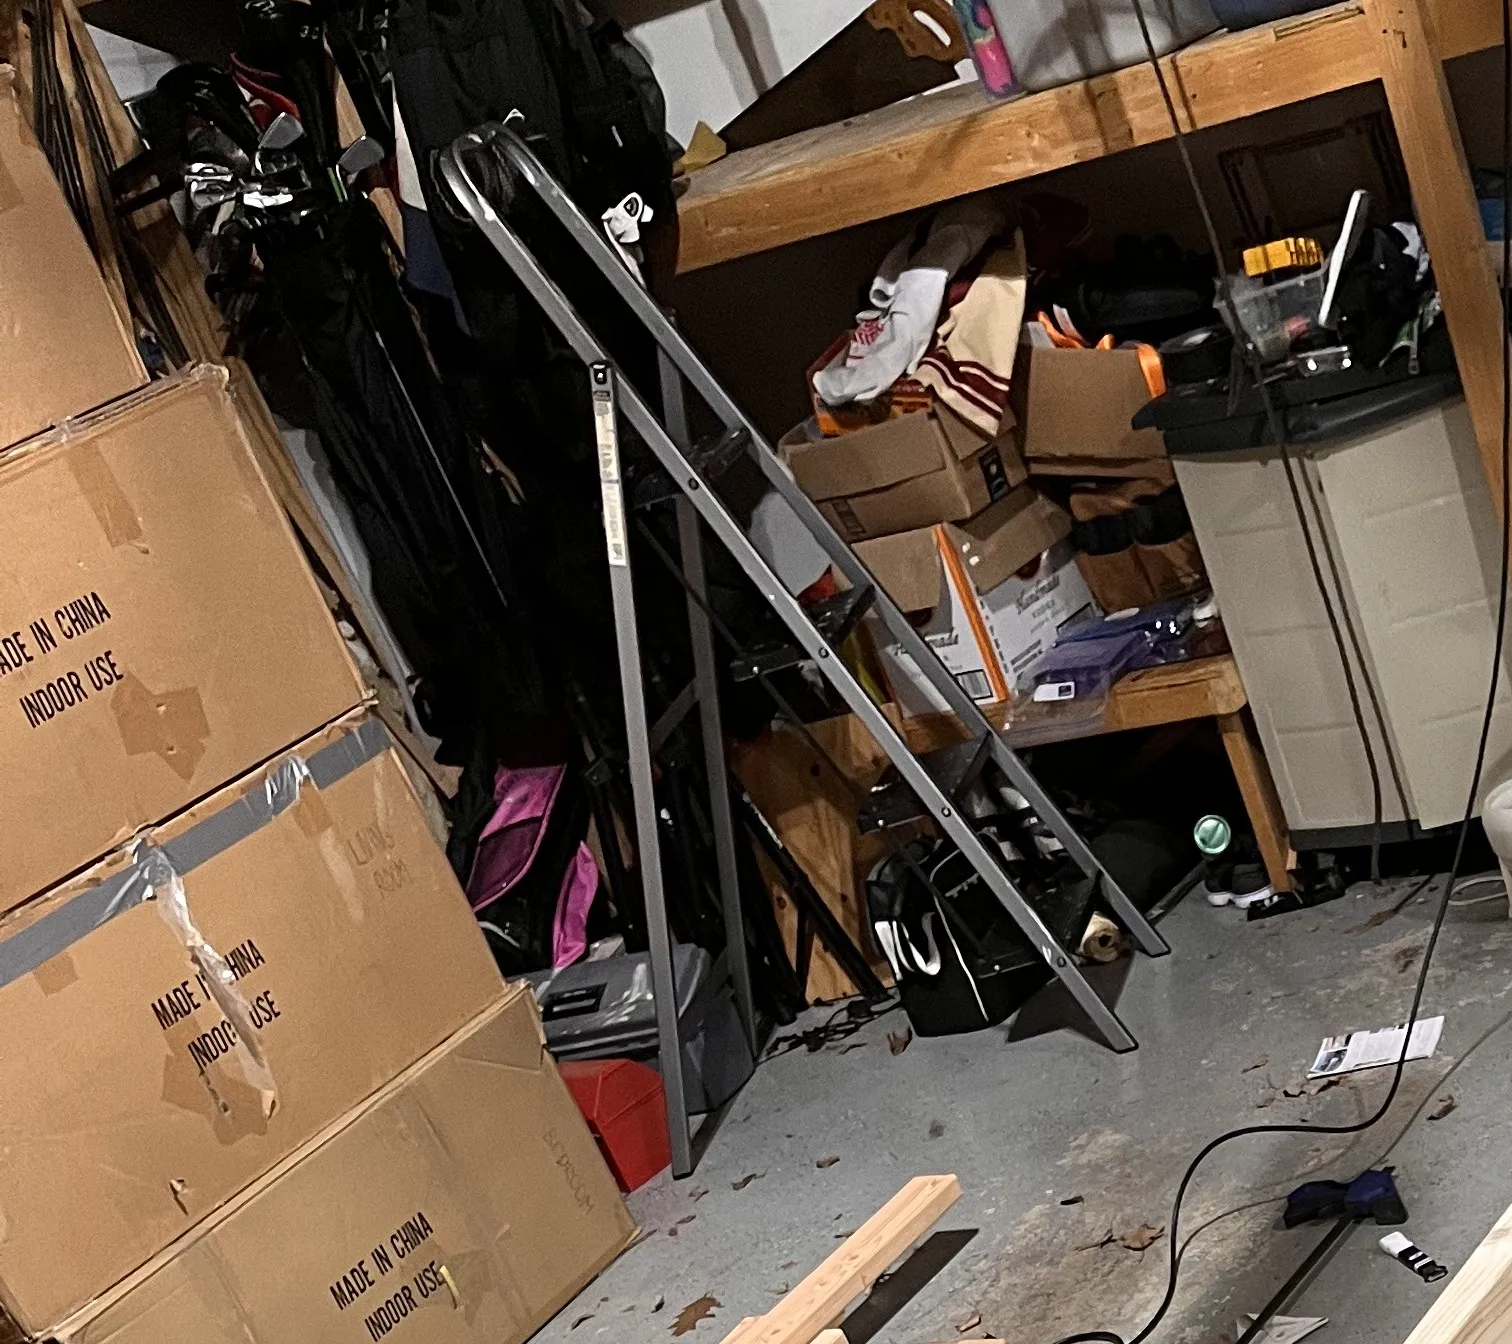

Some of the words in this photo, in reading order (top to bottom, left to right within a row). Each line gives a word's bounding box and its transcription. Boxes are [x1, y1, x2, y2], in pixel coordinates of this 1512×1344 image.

[0, 631, 34, 677] ADE
[30, 618, 57, 654] IN
[54, 592, 111, 640] CHINA
[19, 671, 89, 728] INDOOR
[84, 650, 124, 691] USE
[151, 980, 201, 1031] MADE
[224, 939, 266, 981] HINA
[187, 1020, 238, 1074] INDOO
[249, 990, 281, 1030] USE
[329, 1260, 375, 1311] MADE
[371, 1244, 393, 1276] IN
[390, 1211, 434, 1259] CHINA
[364, 1285, 418, 1343] INDOOR
[413, 1260, 446, 1299] USE
